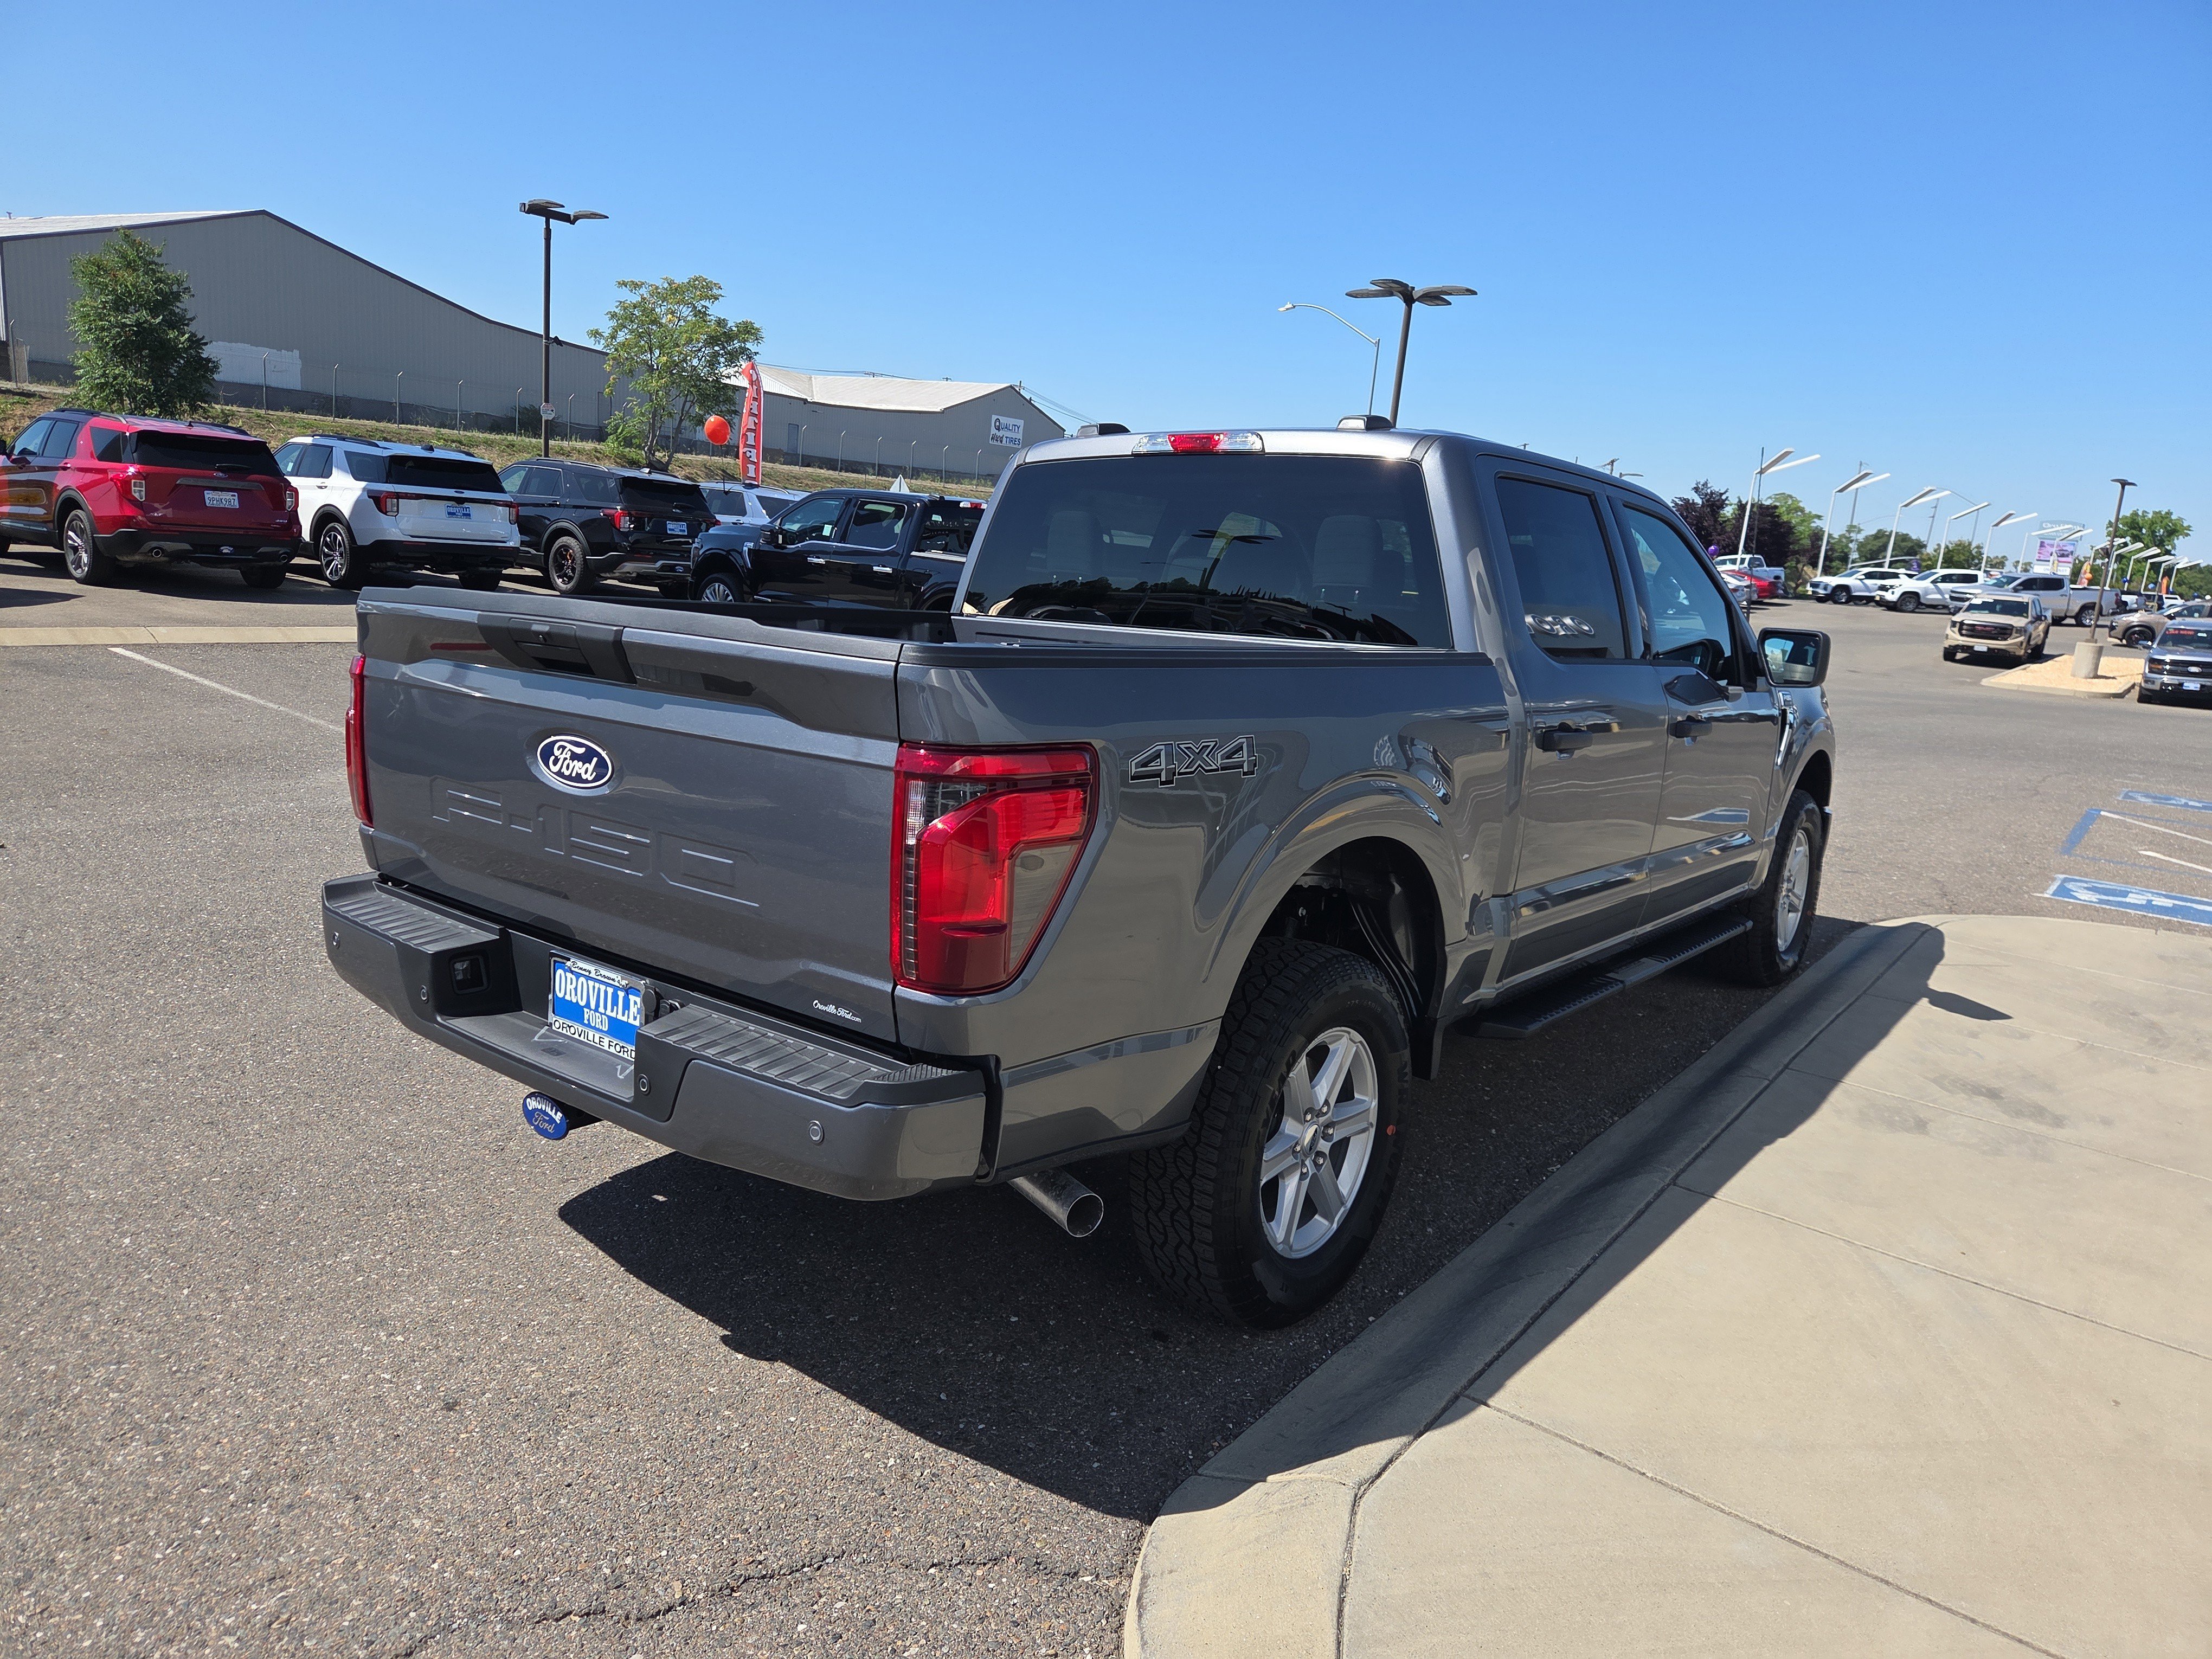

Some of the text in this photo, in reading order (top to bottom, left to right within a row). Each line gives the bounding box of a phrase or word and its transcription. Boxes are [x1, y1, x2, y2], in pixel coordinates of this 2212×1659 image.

[994, 418, 1020, 433] QUALITY
[1005, 436, 1021, 446] TIRES
[208, 497, 235, 505] 9PHK987
[549, 741, 598, 781] Ford
[430, 777, 760, 906] F-150
[571, 961, 623, 986] Benny Brown's
[555, 968, 641, 1027] OROVILLE
[583, 1007, 609, 1031] FORD
[553, 1019, 605, 1047] OROVILLE
[526, 1096, 563, 1124] OROVILLE
[532, 1111, 555, 1134] Ford
